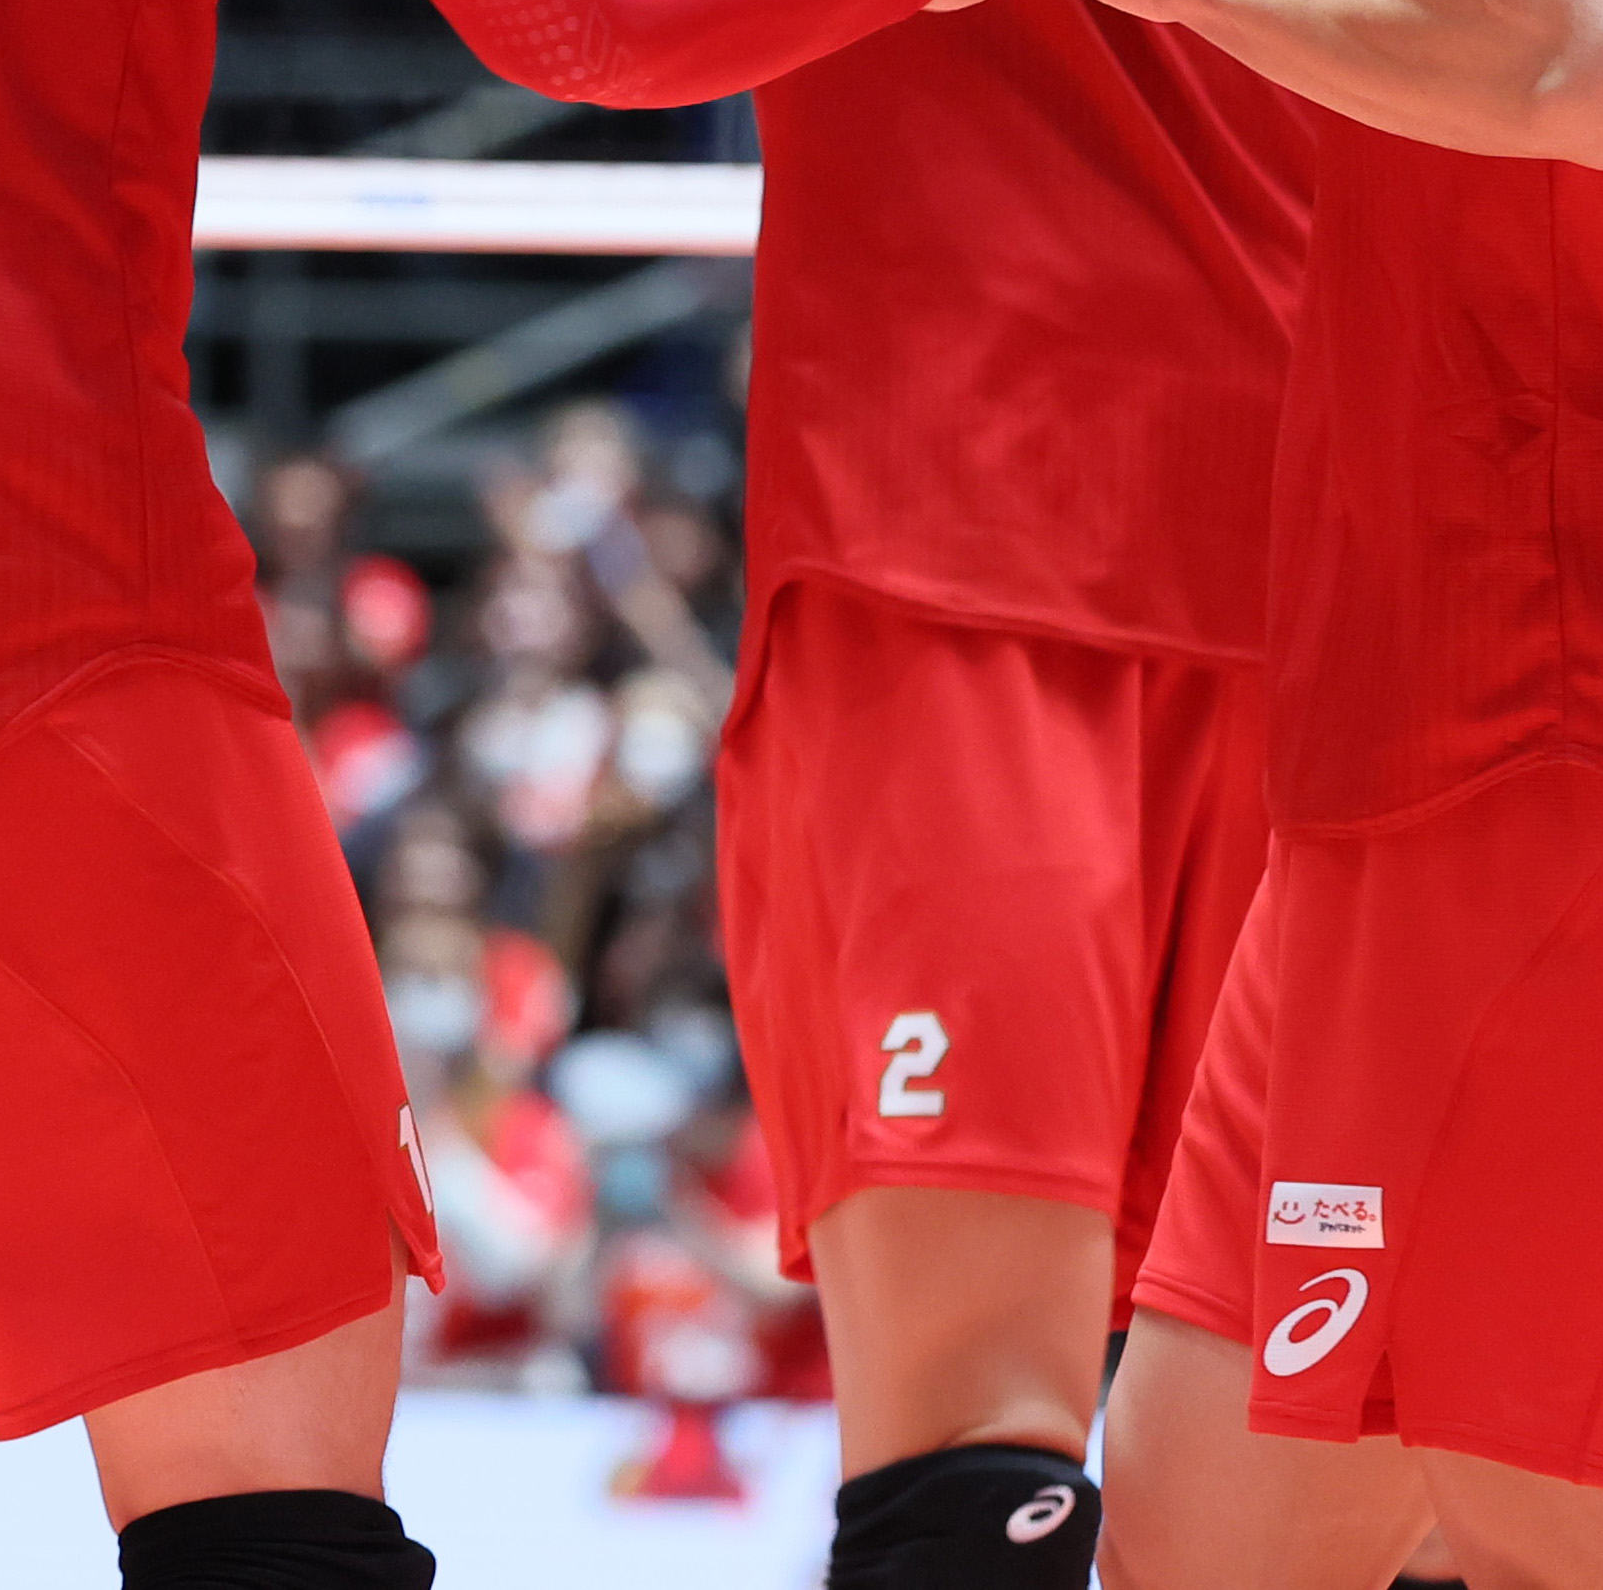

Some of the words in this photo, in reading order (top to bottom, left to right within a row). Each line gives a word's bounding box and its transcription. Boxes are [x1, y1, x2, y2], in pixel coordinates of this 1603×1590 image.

[878, 1008, 952, 1118] 2
[1313, 1198, 1377, 1222] たべる。
